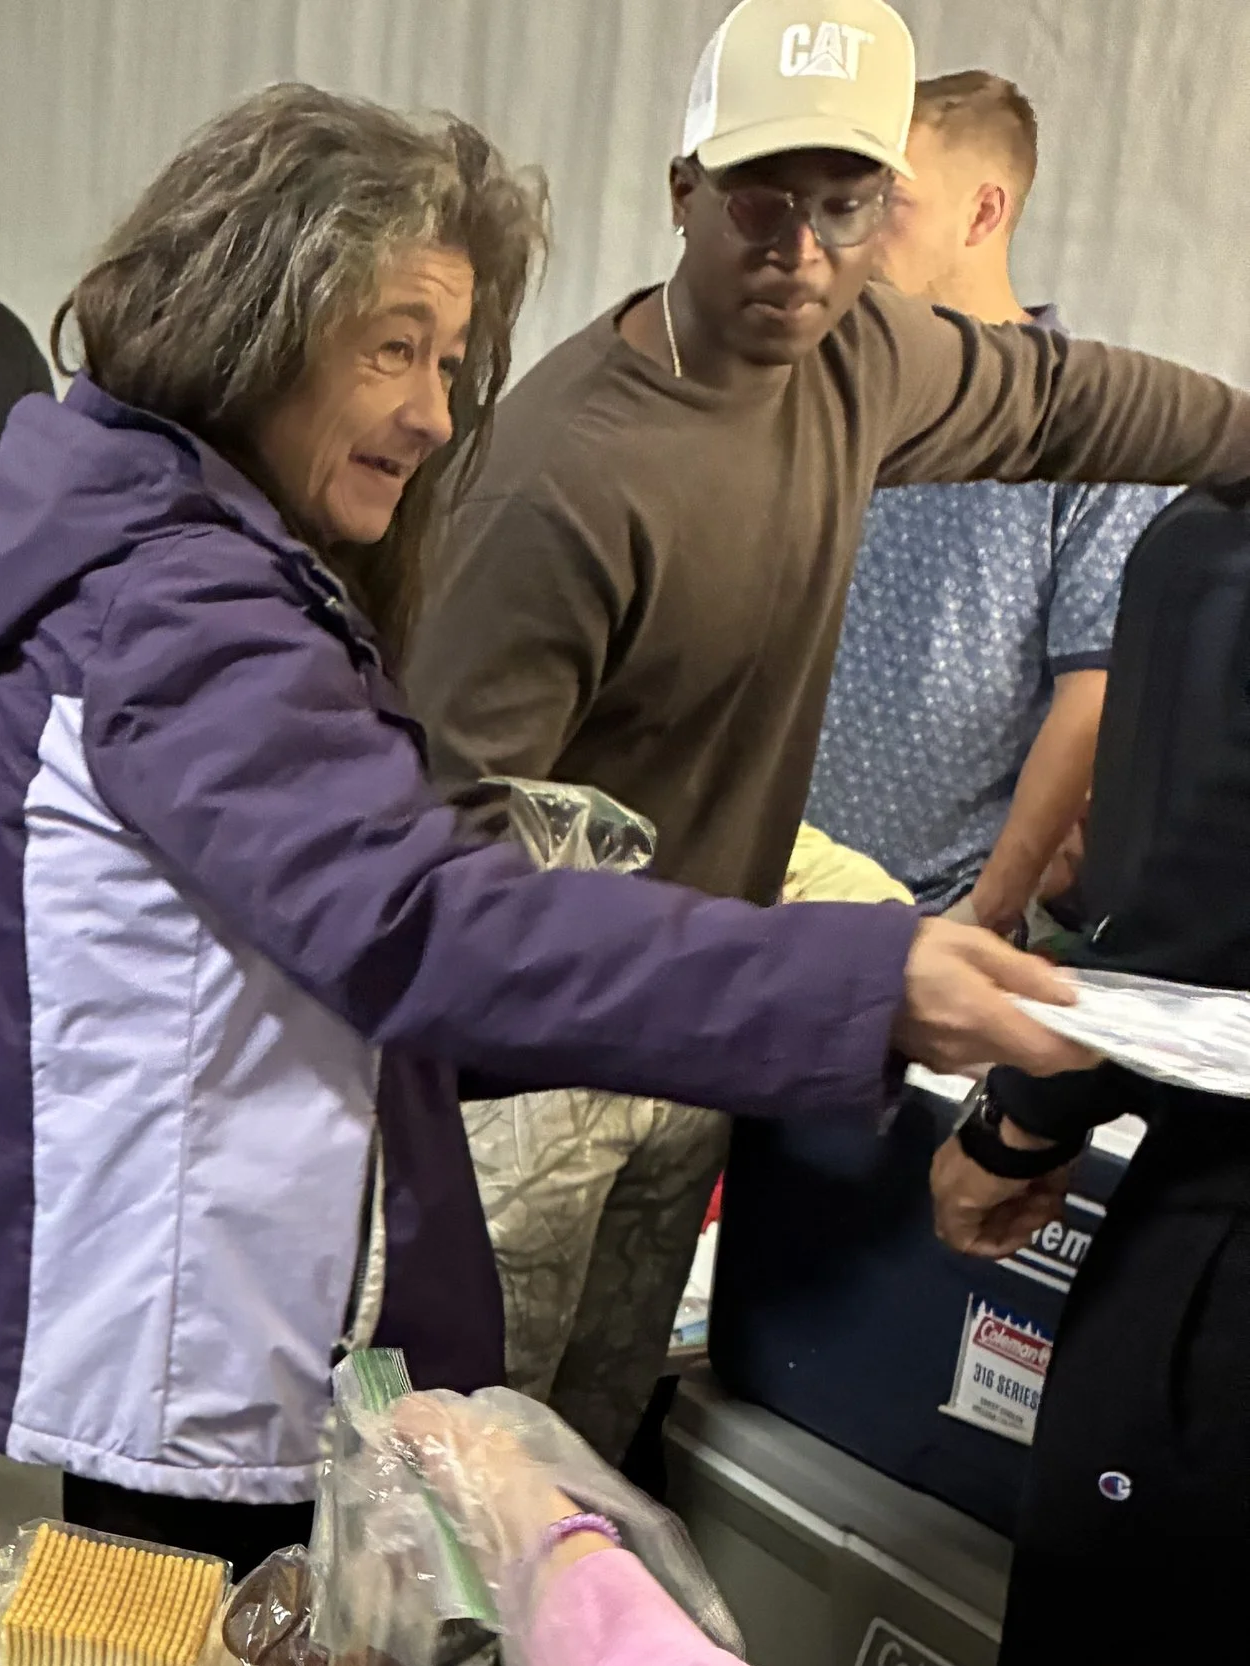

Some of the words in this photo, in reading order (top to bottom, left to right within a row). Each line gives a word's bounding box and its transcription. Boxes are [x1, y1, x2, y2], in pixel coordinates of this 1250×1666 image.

[780, 21, 875, 81] CAT
[973, 1362, 995, 1389] 316
[996, 1373, 1041, 1410] SERIES
